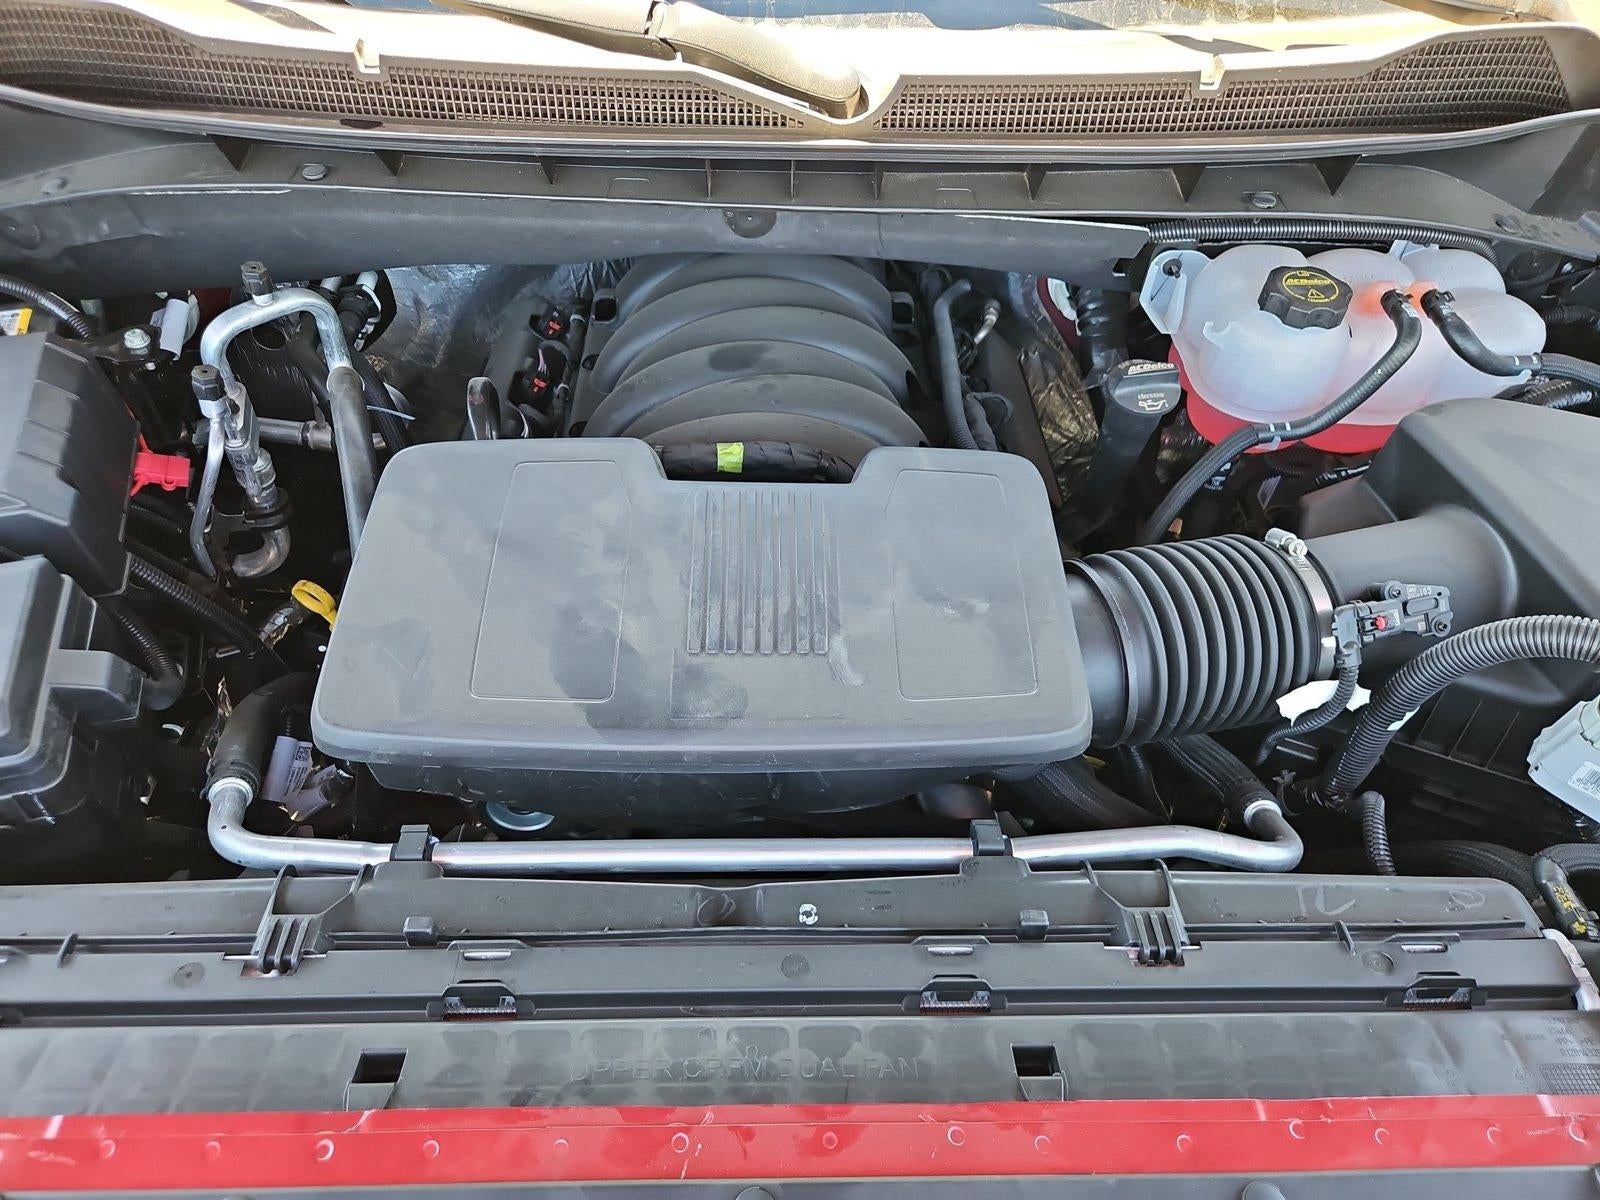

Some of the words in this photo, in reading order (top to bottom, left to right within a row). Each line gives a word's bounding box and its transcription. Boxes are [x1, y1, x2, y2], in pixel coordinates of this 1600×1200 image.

[1285, 278, 1331, 286] ACDelco
[1128, 362, 1175, 375] ACDelco
[569, 1057, 673, 1082] UPPER
[865, 1056, 920, 1080] FAN
